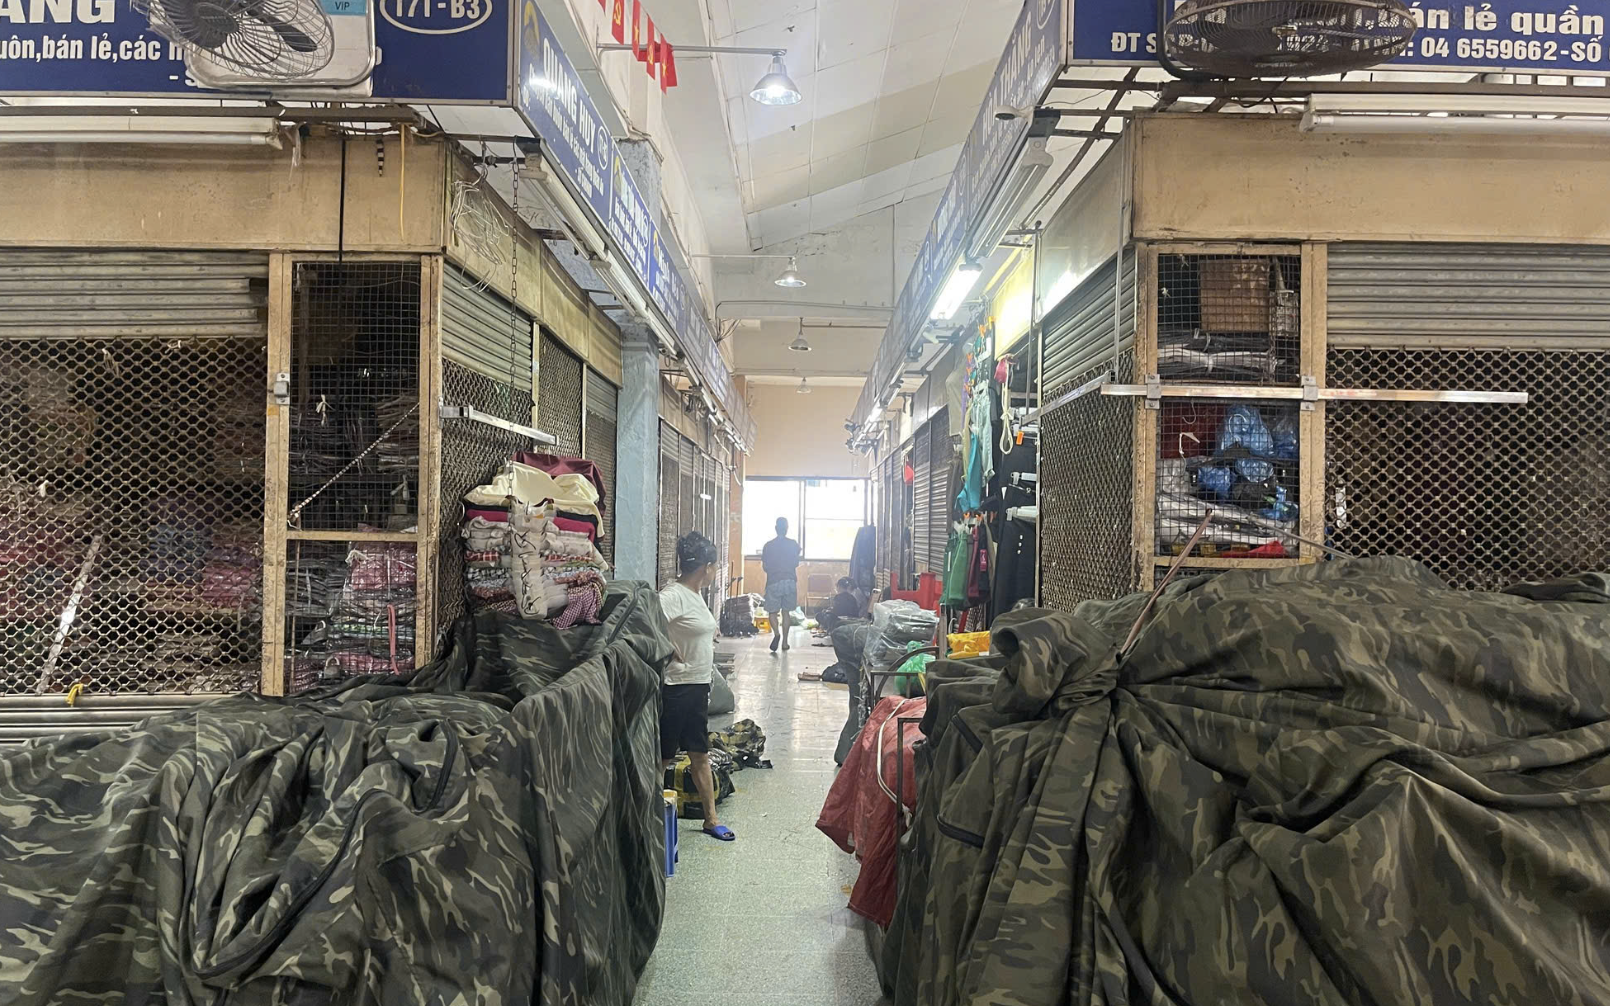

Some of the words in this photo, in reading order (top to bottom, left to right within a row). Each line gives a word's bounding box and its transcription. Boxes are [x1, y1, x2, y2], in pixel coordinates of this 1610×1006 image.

[335, 1, 350, 10] VIP
[1464, 3, 1497, 31] lẻ
[1510, 5, 1604, 36] quần
[1111, 32, 1141, 53] ĐT
[1421, 37, 1450, 58] 04
[579, 98, 596, 155] HUY
